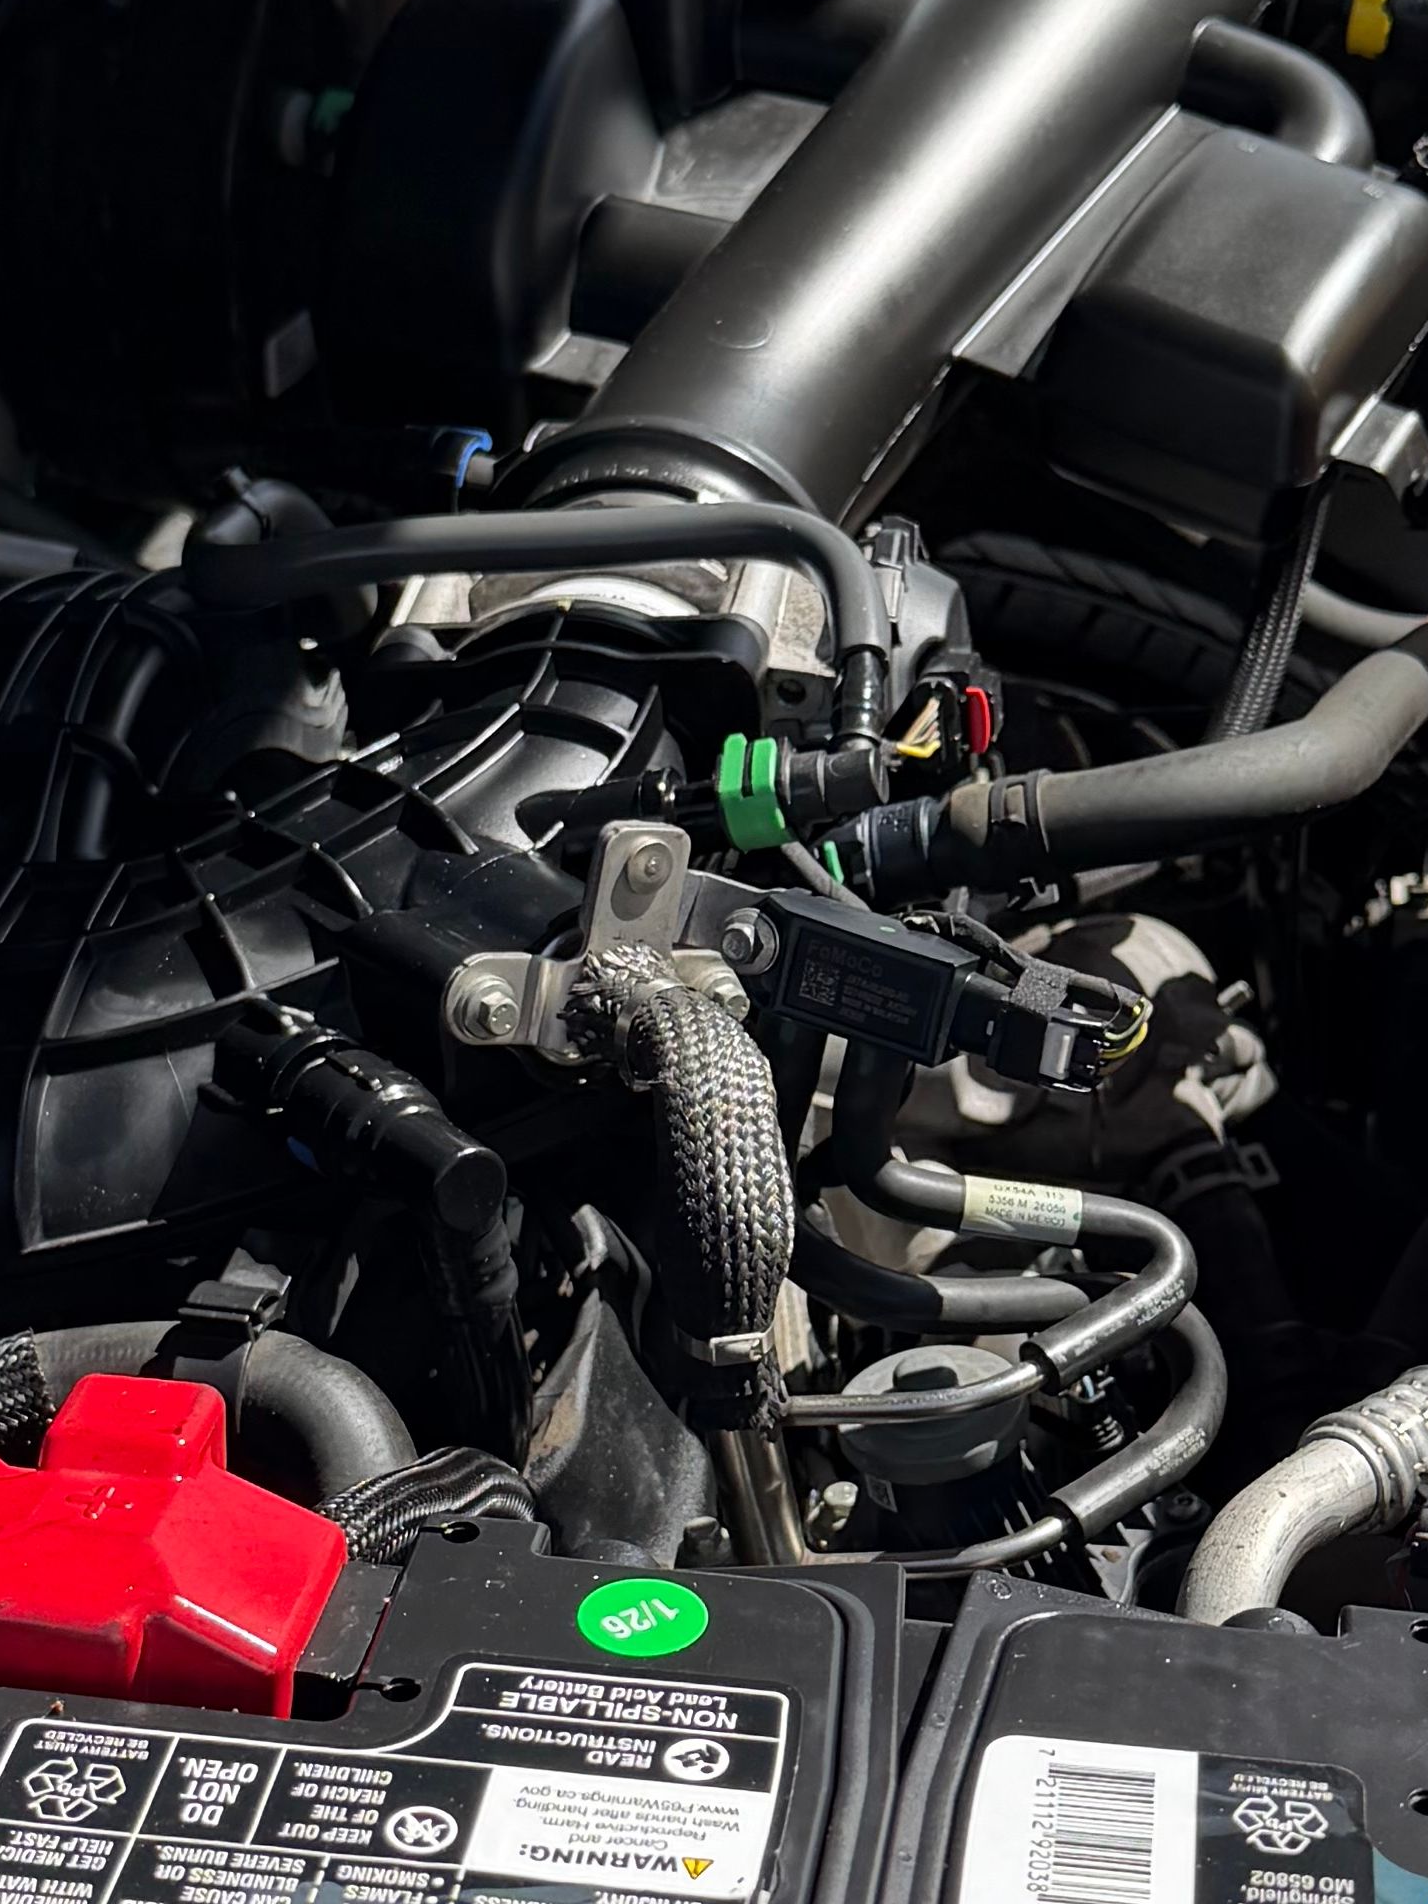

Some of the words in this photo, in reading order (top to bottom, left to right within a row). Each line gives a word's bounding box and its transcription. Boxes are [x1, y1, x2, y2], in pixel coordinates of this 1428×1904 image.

[600, 1598, 680, 1640] 1/26
[519, 1675, 605, 1699] Battery
[610, 1685, 664, 1705] Acid
[498, 1690, 738, 1729] NON-SPILLABLE
[669, 1691, 727, 1710] Lead
[33, 1739, 78, 1753] MUST
[44, 1729, 125, 1746] RECYCLED
[125, 1738, 149, 1749] BE
[480, 1722, 657, 1753] INSTRUCTIONS.
[80, 1743, 149, 1760] BATTERY
[585, 1750, 652, 1769] READ
[178, 1757, 259, 1783] OPEN.
[293, 1761, 393, 1786] CHILDREN.
[56, 1782, 87, 1797] Pb
[178, 1779, 241, 1803] NOT
[290, 1781, 318, 1799] OF
[319, 1783, 386, 1805] REACH
[310, 1803, 348, 1822] THE
[512, 1797, 587, 1818] handling.
[1031, 1777, 1057, 1829] 21112
[178, 1802, 224, 1827] DO
[350, 1808, 379, 1825] OF
[538, 1815, 589, 1831] Harm.
[592, 1807, 631, 1822] after
[634, 1811, 687, 1827] hands
[277, 1821, 320, 1840] OUT
[595, 1820, 706, 1842] Reproductive
[692, 1816, 740, 1833] Wash
[1264, 1817, 1294, 1833] Pb
[8, 1830, 60, 1849] FAST.
[322, 1825, 372, 1846] KEEP
[568, 1832, 600, 1846] and
[606, 1835, 668, 1852] Cancer
[59, 1837, 114, 1855] HELP
[154, 1844, 229, 1866] BURNS.
[67, 1854, 107, 1871] GET
[230, 1851, 306, 1873] SEVERE
[518, 1843, 678, 1874] WARNING:
[1025, 1839, 1054, 1893] 92038
[154, 1864, 186, 1881] OR
[188, 1866, 299, 1892] BLINDNESS
[336, 1864, 430, 1888] SMOKING
[1250, 1869, 1315, 1888] 65802
[42, 1879, 93, 1898] WITH
[1318, 1876, 1354, 1895] MO
